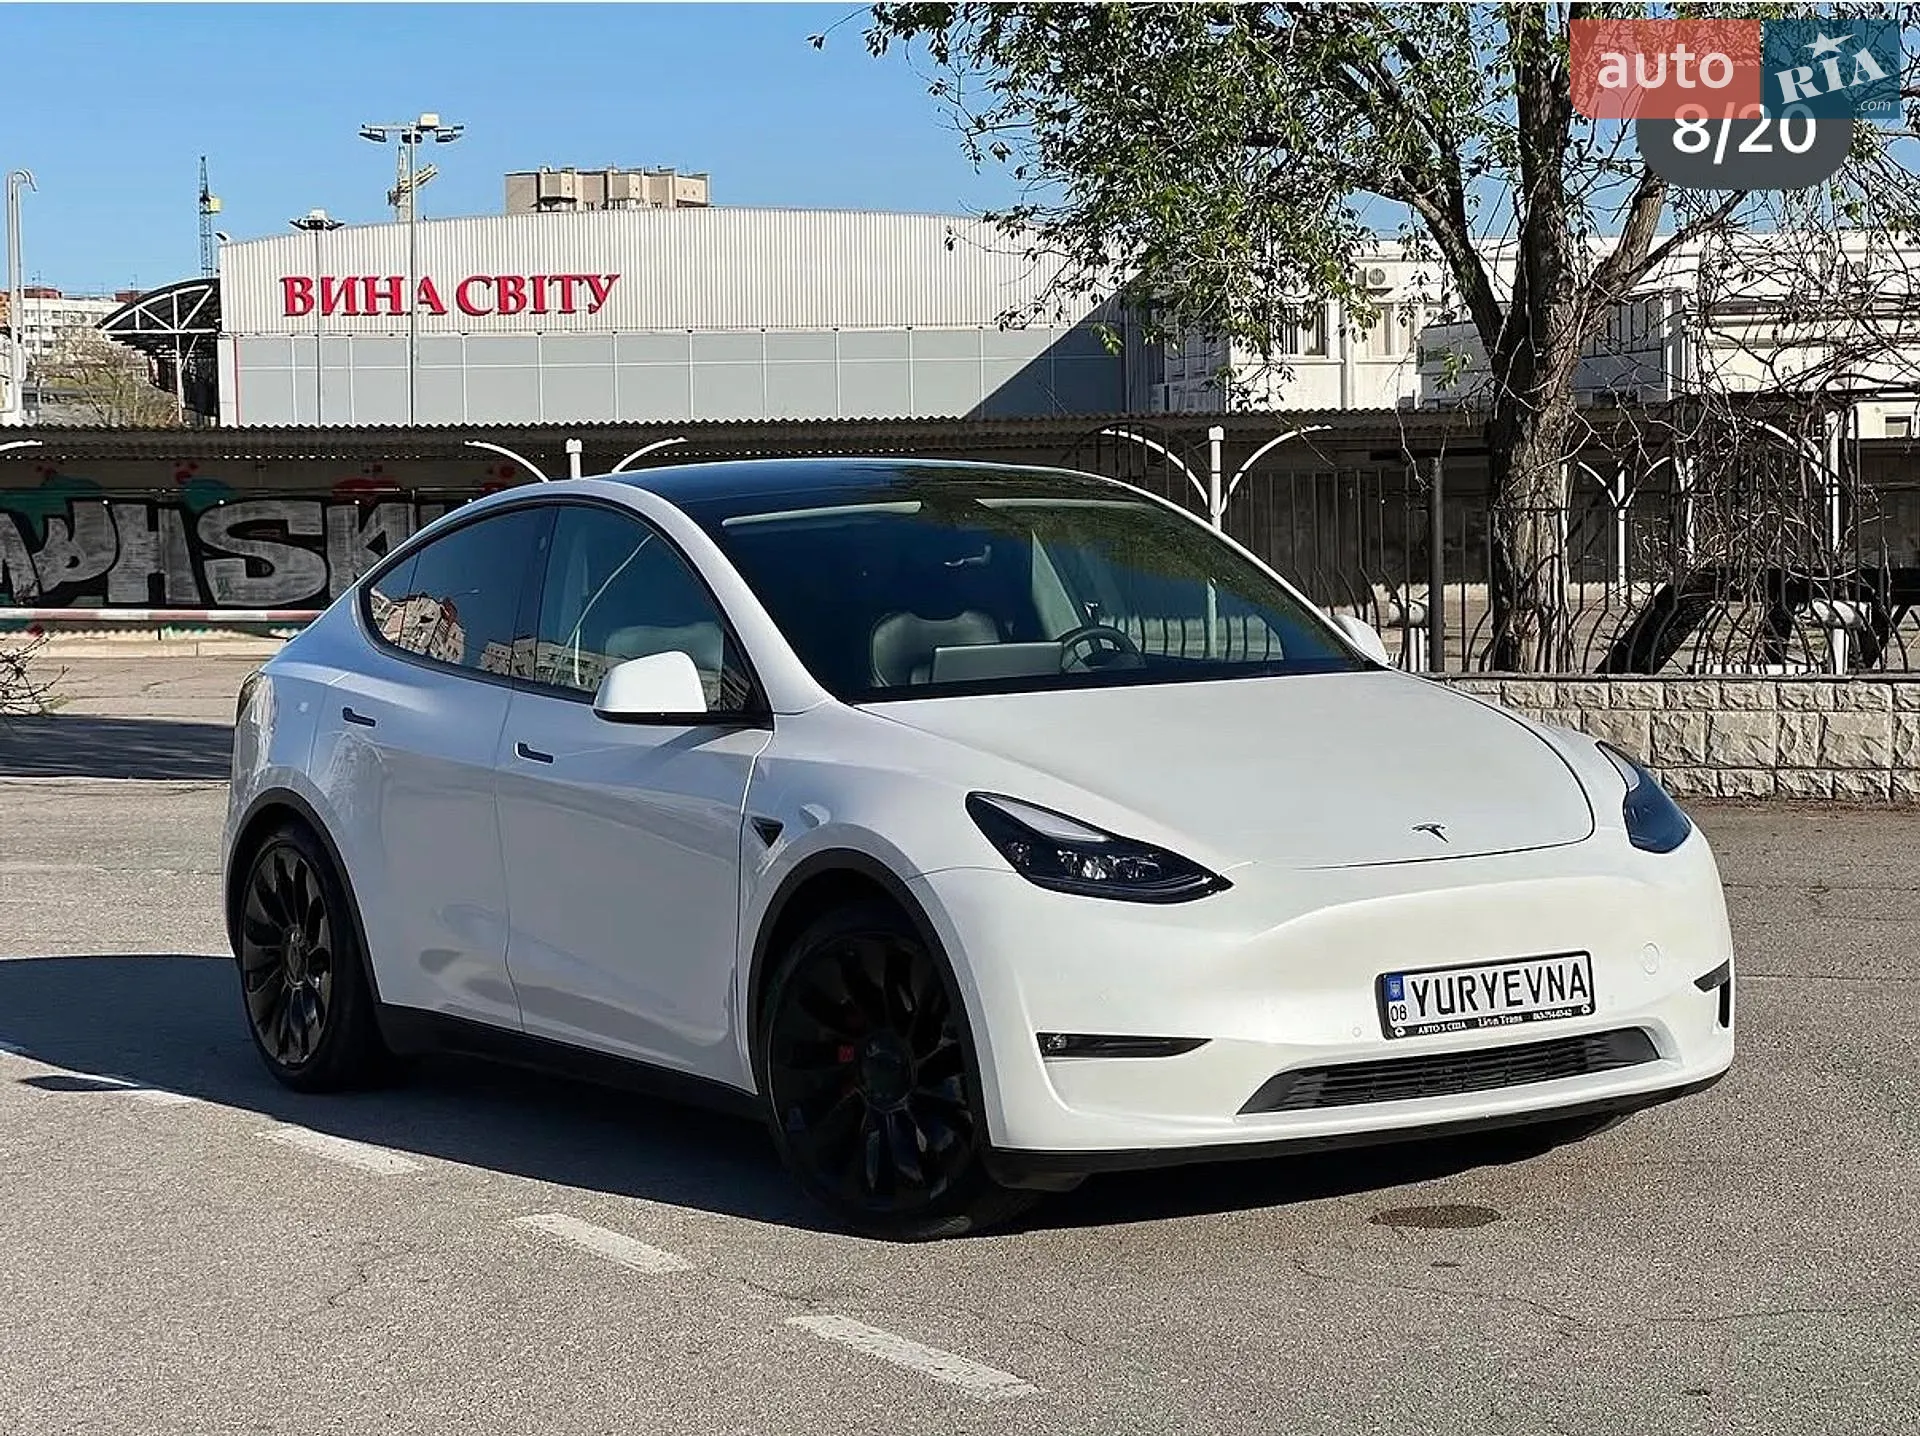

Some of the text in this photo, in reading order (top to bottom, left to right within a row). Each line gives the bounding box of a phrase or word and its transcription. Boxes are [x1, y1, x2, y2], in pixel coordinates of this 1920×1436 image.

[279, 273, 621, 317] ВИНА СВІТУ
[1411, 962, 1588, 1017] YURYEVNA
[1390, 1004, 1407, 1022] 08
